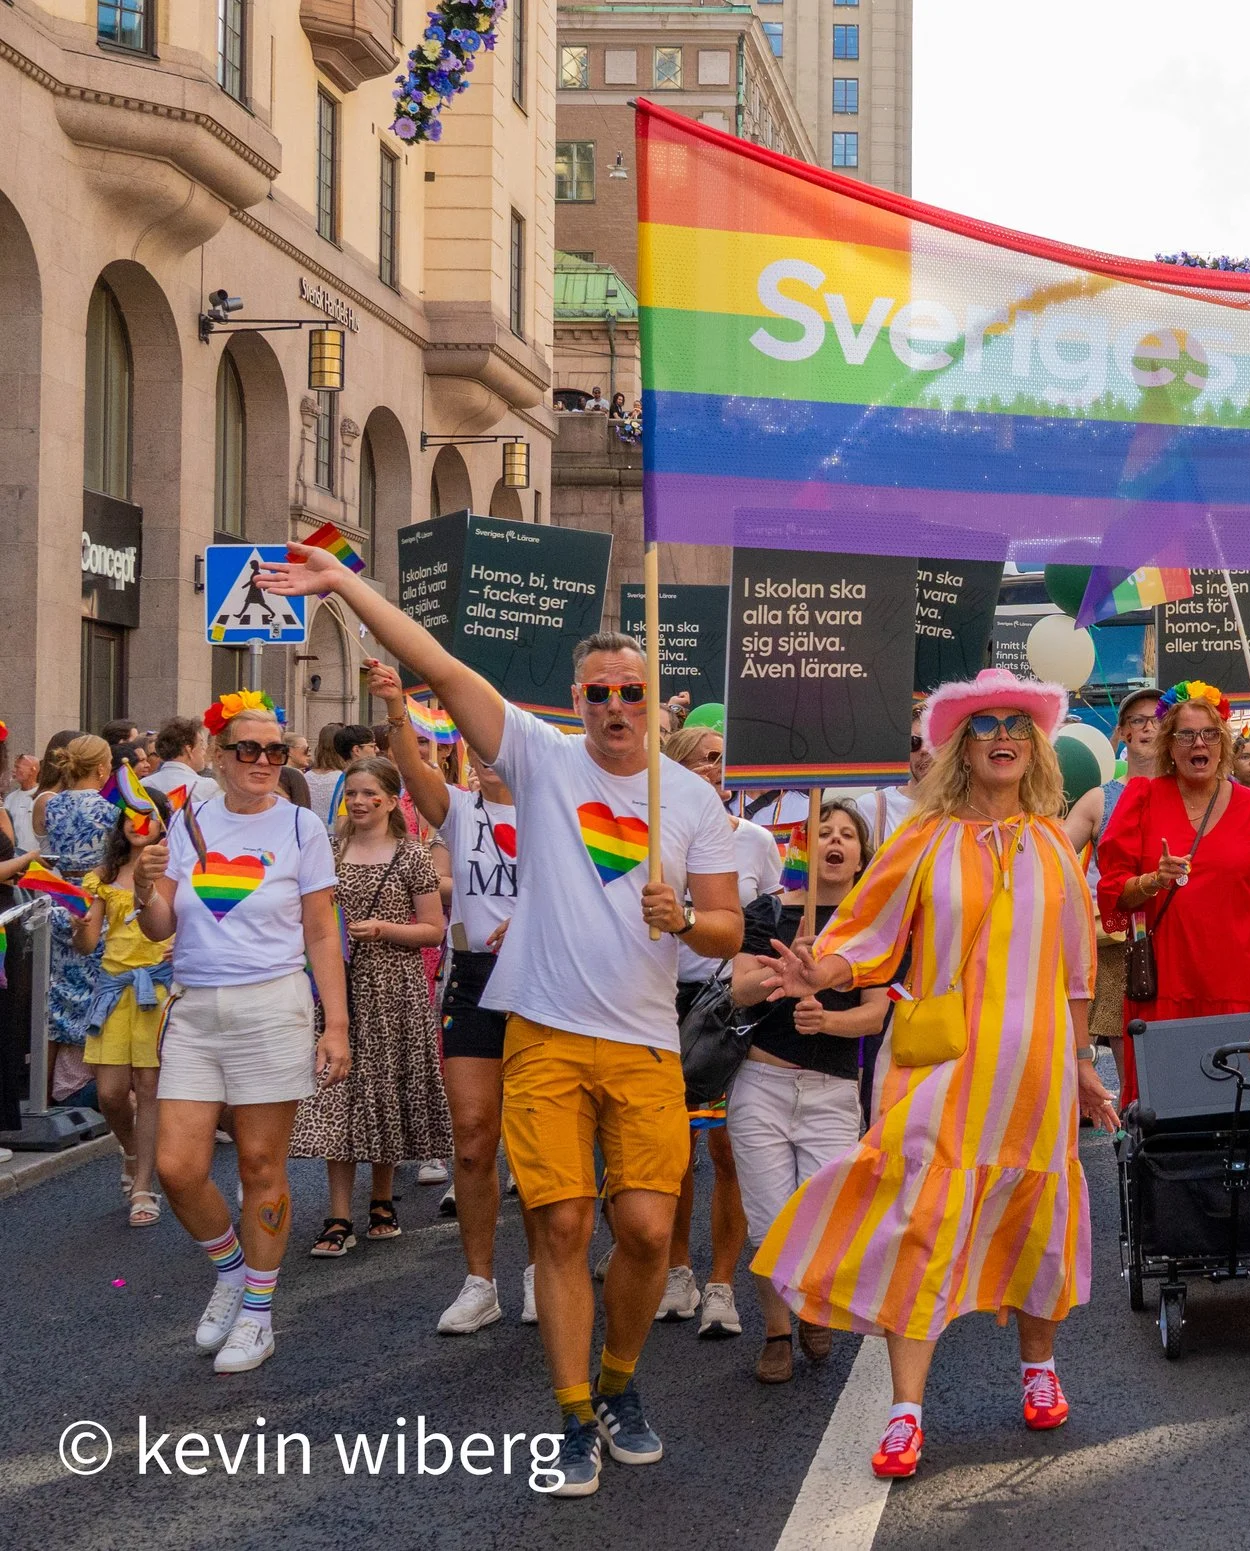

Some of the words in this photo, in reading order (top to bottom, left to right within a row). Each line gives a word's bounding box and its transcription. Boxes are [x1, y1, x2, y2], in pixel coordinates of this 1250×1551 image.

[749, 258, 1238, 402] Sveriges
[475, 528, 505, 539] Sveriges
[517, 534, 541, 543] Lärare
[81, 530, 137, 591] Concept
[402, 570, 406, 584] I
[406, 566, 432, 583] skolan
[432, 561, 448, 576] ska
[470, 564, 525, 587] Homo,
[528, 572, 549, 590] bi,
[552, 577, 596, 595] trans
[935, 570, 964, 587] ska
[402, 586, 417, 601] alla
[418, 580, 427, 596] få
[427, 579, 447, 593] vara
[483, 585, 536, 606] facket
[539, 596, 568, 610] ger
[743, 578, 750, 598] I
[754, 577, 825, 599] skolan
[829, 578, 867, 599] ska
[922, 588, 958, 605] vara
[1206, 580, 1249, 598] ingen
[415, 598, 441, 617] själva.
[466, 603, 497, 619] alla
[499, 608, 564, 628] samma
[742, 604, 783, 625] alla
[787, 602, 810, 625] få
[814, 609, 864, 626] vara
[1165, 600, 1204, 617] plats
[1206, 598, 1229, 614] för
[423, 614, 449, 628] lärare.
[463, 621, 520, 640] chans!
[626, 620, 631, 632] I
[632, 620, 675, 633] skan
[676, 621, 700, 633] ska
[914, 619, 956, 640] ärare.
[1165, 619, 1221, 634] homo-,
[633, 634, 647, 647] lla
[668, 637, 698, 648] vara
[741, 632, 774, 657] sig
[777, 631, 846, 657] själva.
[996, 640, 999, 650] I
[1000, 640, 1021, 650] mitt
[1165, 637, 1198, 653] eller
[996, 651, 1019, 660] finns
[660, 664, 702, 676] lärare.
[740, 653, 796, 678] Även
[800, 657, 868, 678] lärare.
[995, 661, 1019, 670] plats
[1020, 661, 1032, 670] fö
[471, 820, 490, 854] I
